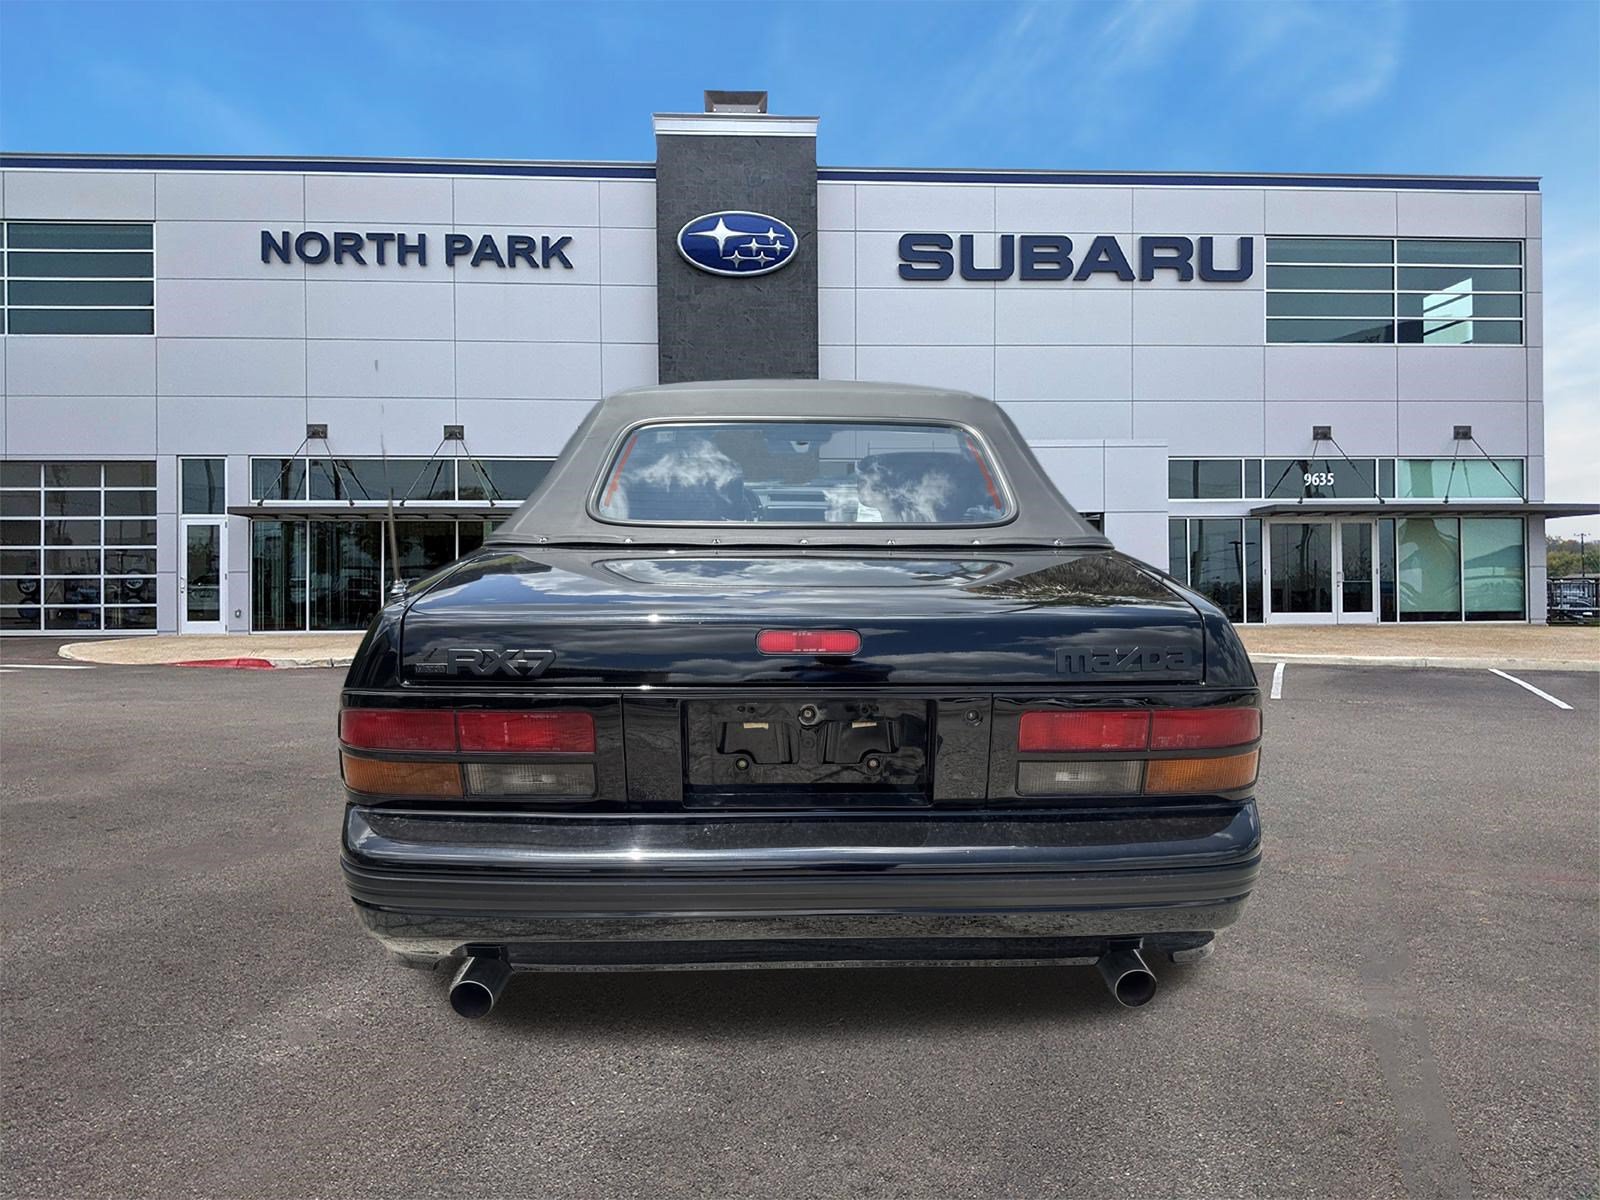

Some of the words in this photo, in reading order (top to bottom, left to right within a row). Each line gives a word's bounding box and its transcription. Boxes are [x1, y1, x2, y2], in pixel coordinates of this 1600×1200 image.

[260, 230, 427, 267] NORTH
[445, 233, 574, 269] PARK
[898, 233, 1254, 283] SUBARU
[1303, 472, 1335, 486] 9635
